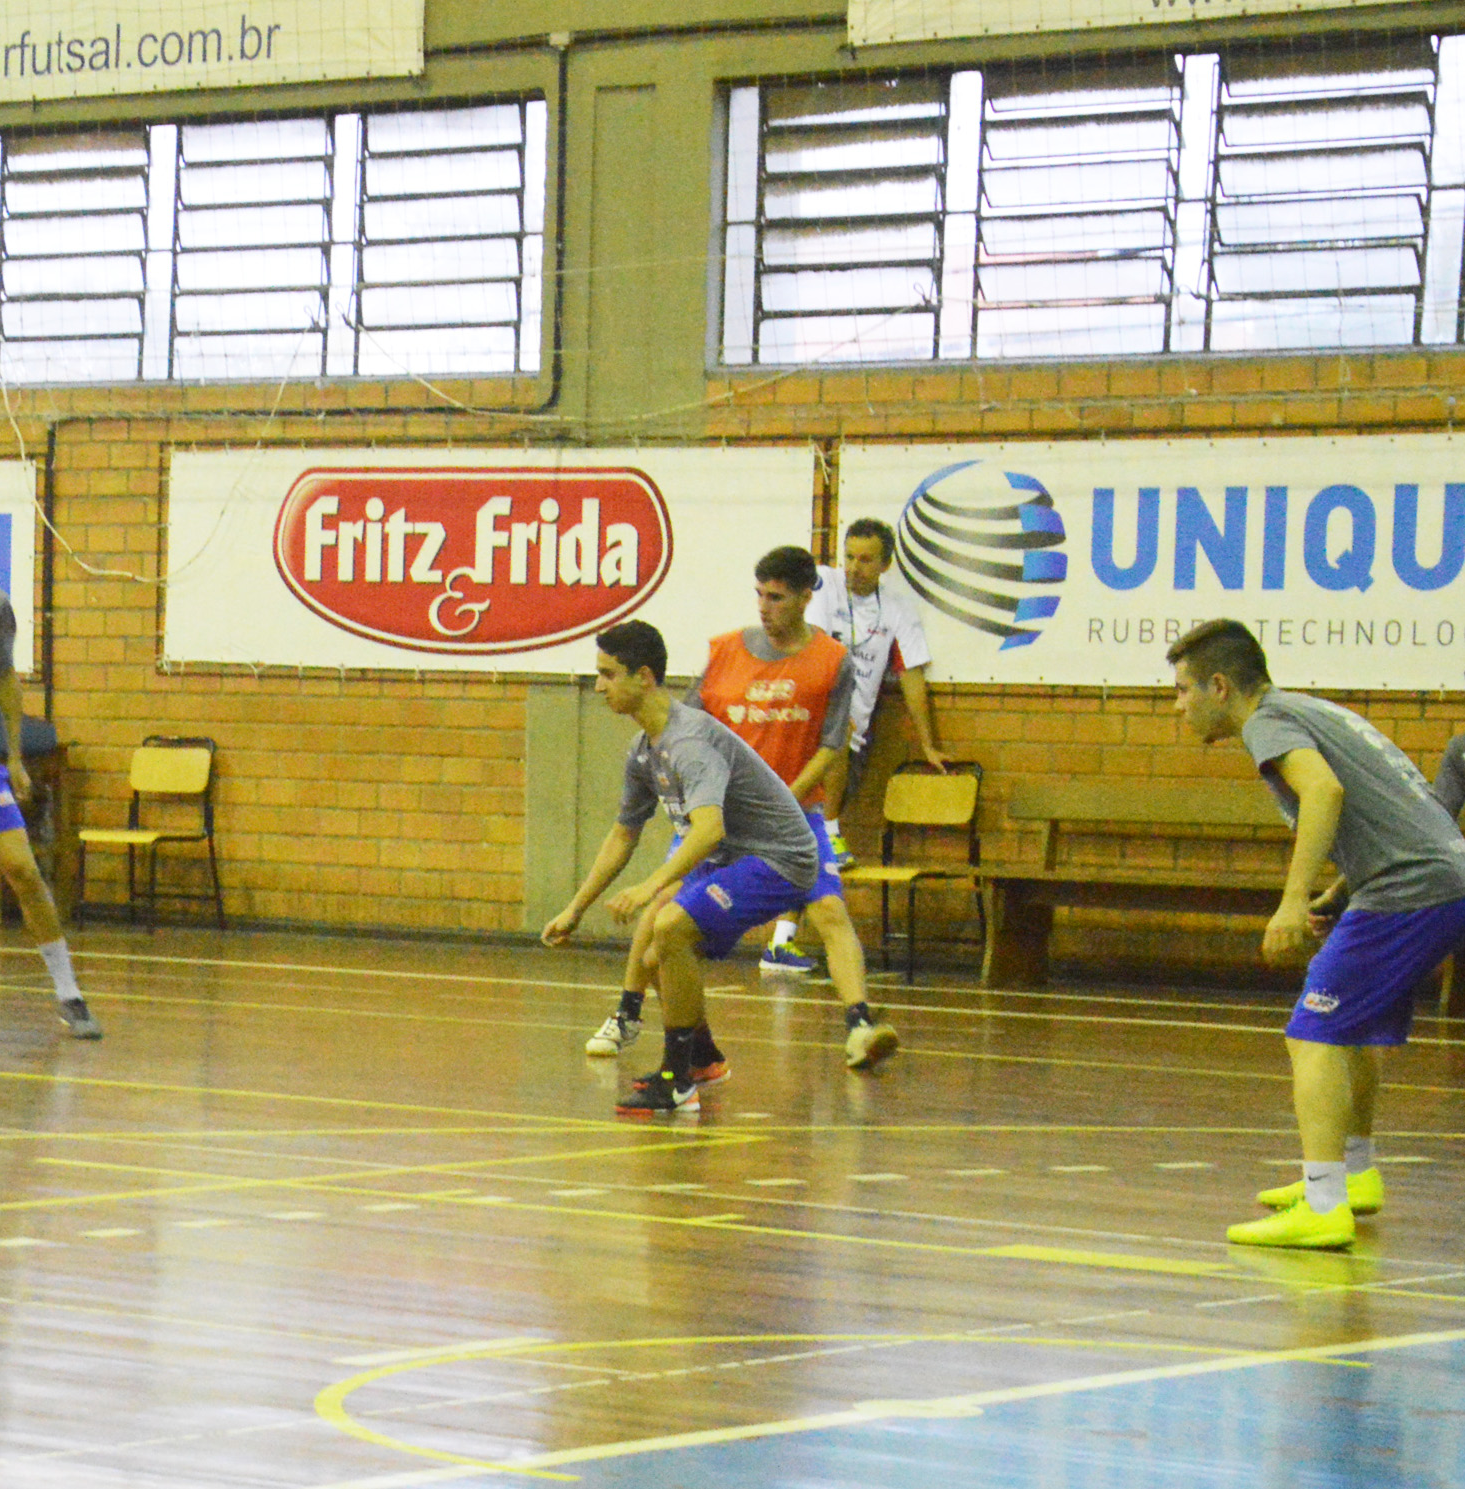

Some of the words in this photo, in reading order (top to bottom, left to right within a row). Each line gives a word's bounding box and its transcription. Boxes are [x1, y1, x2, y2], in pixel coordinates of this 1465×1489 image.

[304, 496, 446, 583] Fritz
[473, 496, 639, 588] Frida
[1091, 483, 1465, 592] UNIQU
[1088, 618, 1207, 646] RUBB
[1254, 619, 1465, 647] TECHNOLO
